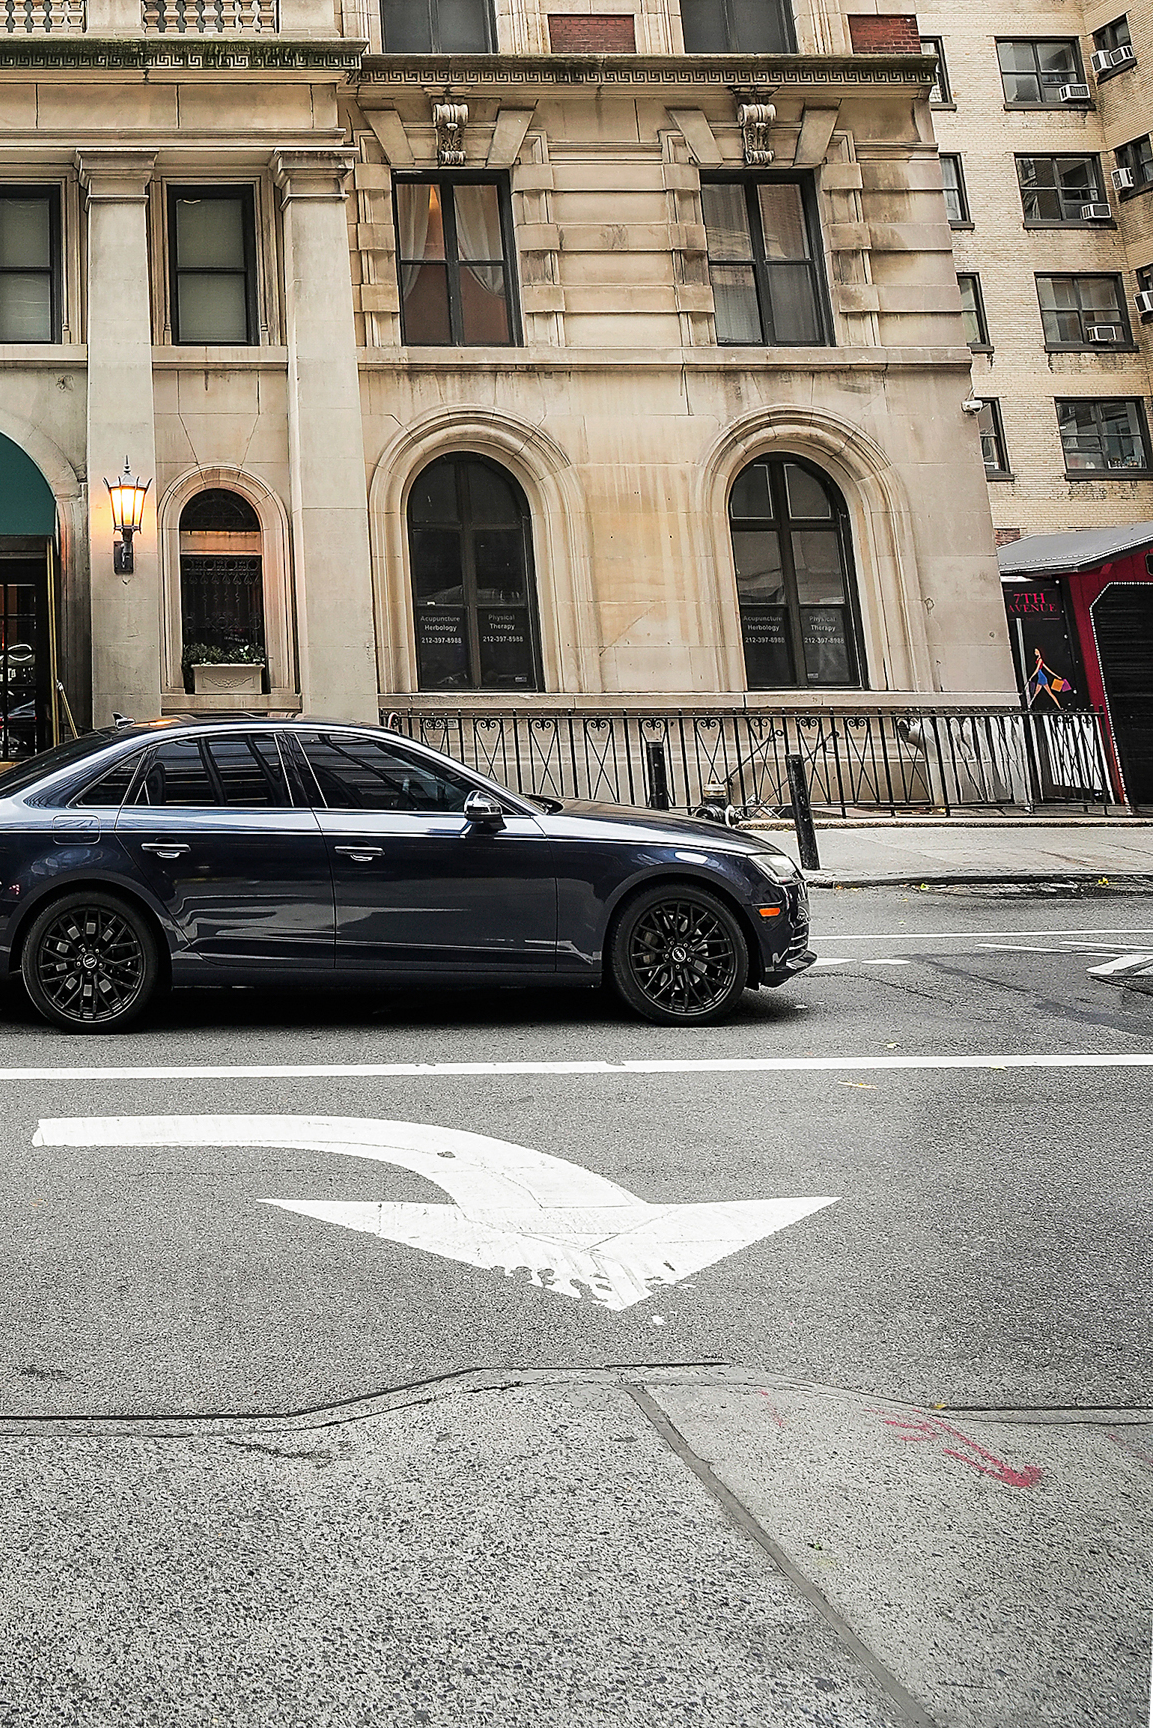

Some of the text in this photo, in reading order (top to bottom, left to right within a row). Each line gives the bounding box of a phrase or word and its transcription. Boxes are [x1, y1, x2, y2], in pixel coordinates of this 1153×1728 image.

[1013, 593, 1046, 604] 7TH
[1008, 604, 1057, 613] AVENUE
[420, 615, 460, 624] Acupuncture
[488, 614, 515, 622] Physical
[424, 624, 457, 632] Herbology
[747, 624, 780, 632] Herbology
[810, 624, 836, 632] Therapy
